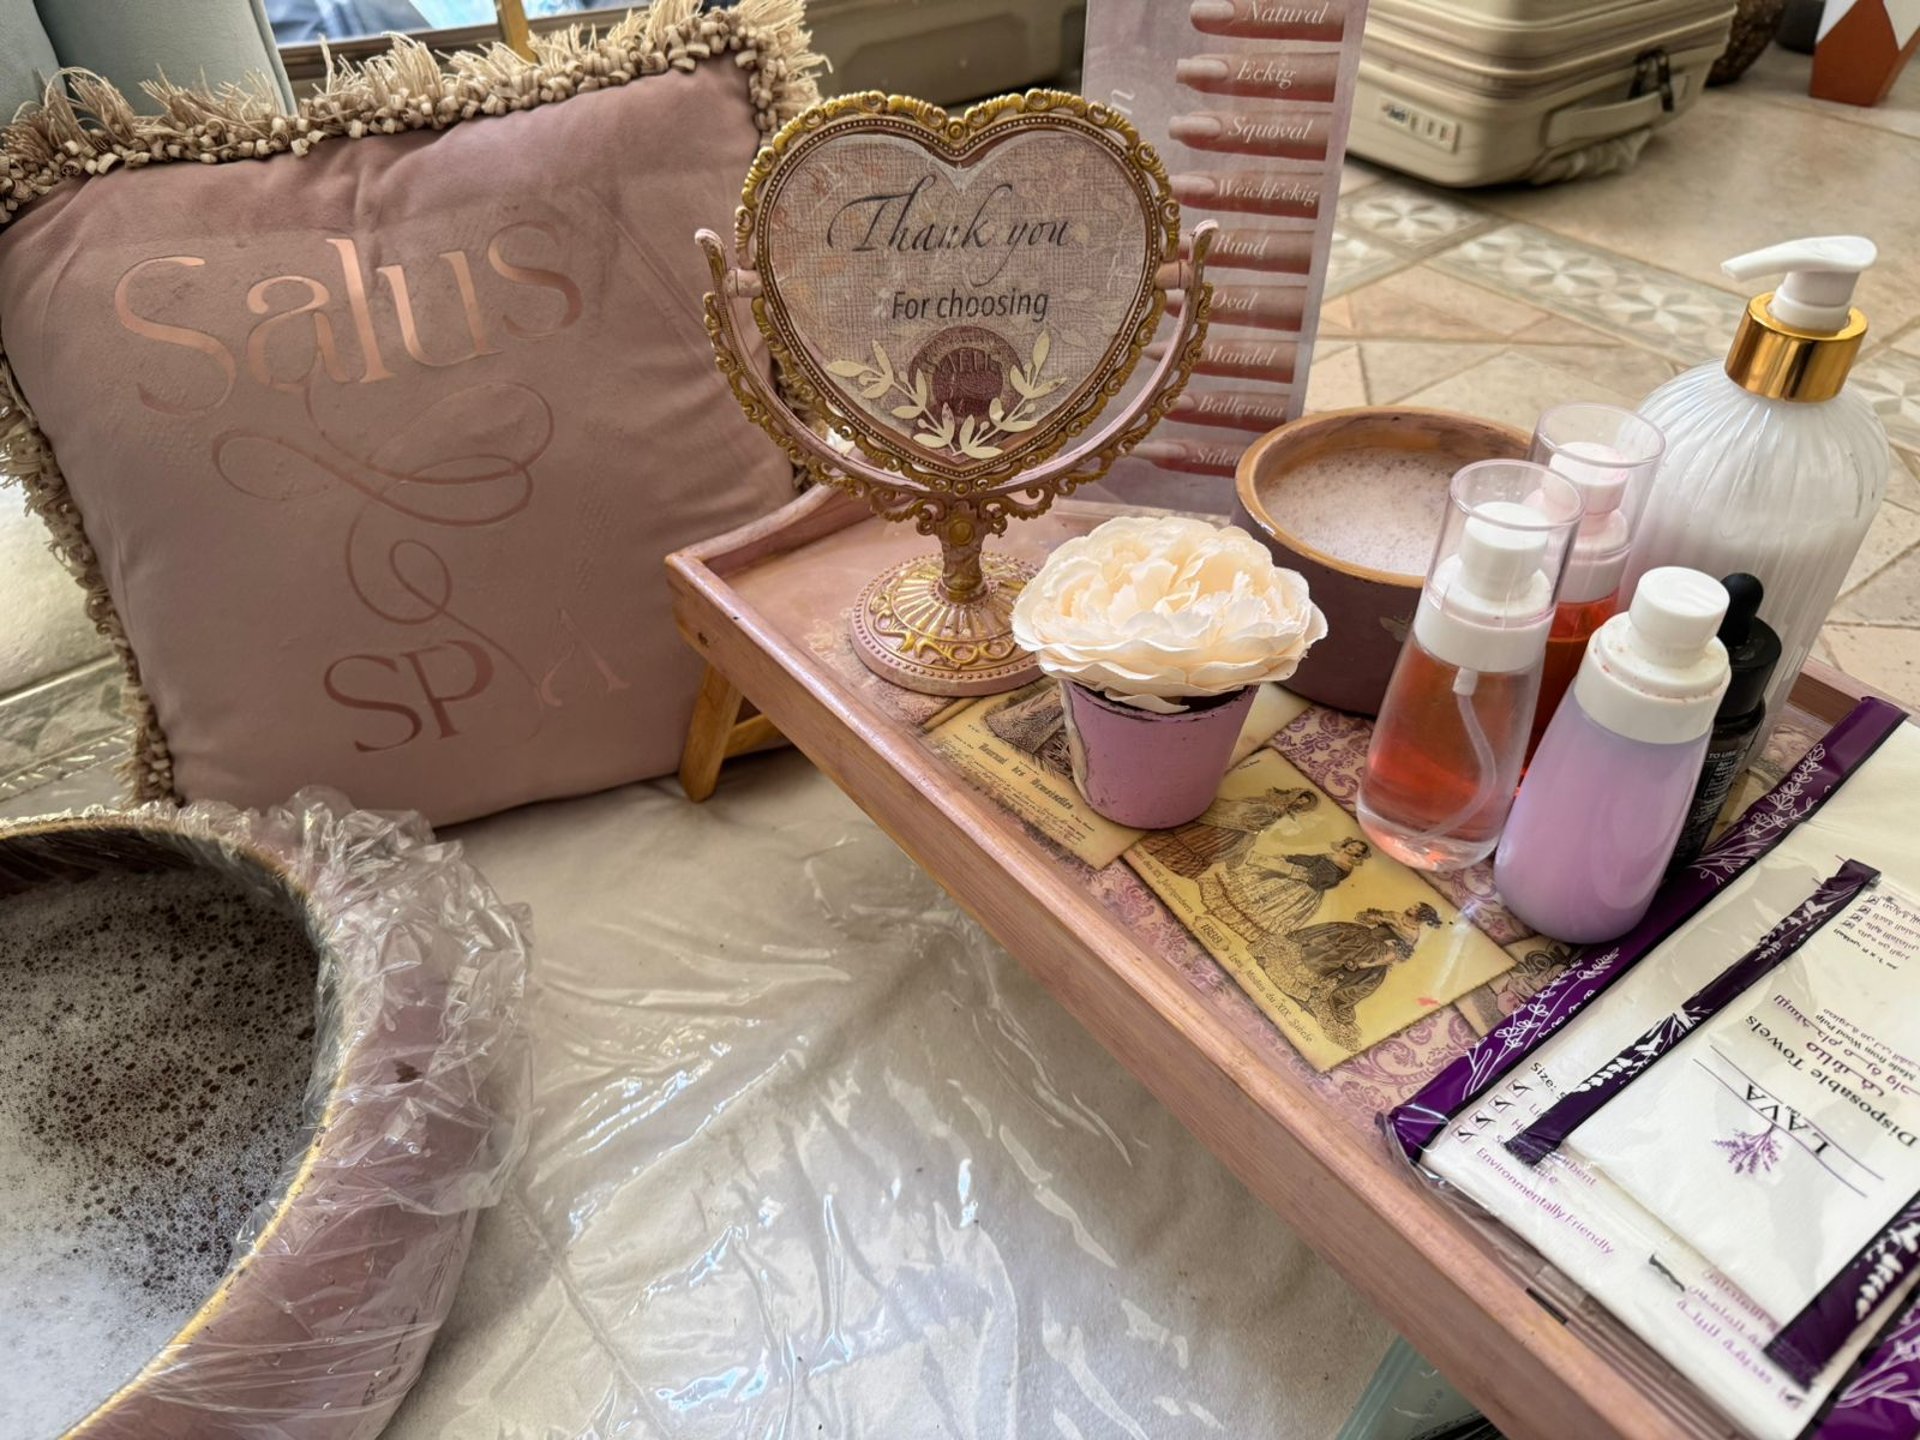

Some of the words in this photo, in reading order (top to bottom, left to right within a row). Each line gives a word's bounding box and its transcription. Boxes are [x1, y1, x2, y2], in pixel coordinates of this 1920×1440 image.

[1242, 1, 1330, 25] Natural
[1236, 61, 1297, 90] Eckig
[1228, 117, 1314, 143] Squoval
[826, 174, 1012, 253] Thank
[965, 217, 1073, 288] you
[1214, 234, 1269, 257] Rund
[892, 291, 930, 321] For
[936, 287, 1050, 323] choosing
[1210, 292, 1260, 312] Oval
[114, 220, 584, 417] Salus
[1201, 345, 1277, 367] Mandel
[1197, 395, 1284, 418] Ballerina
[1815, 1013, 1837, 1032] Pulp
[1745, 1015, 1805, 1072] Towels
[1836, 1029, 1863, 1050] Wood
[1864, 1047, 1888, 1064] from
[1530, 1062, 1557, 1092] Size:
[1888, 1062, 1917, 1082] Made
[1743, 1083, 1832, 1157] LAVA
[1809, 1068, 1919, 1148] Disposable
[1476, 1147, 1566, 1220] Environmentally
[1564, 1212, 1615, 1255] Friendly
